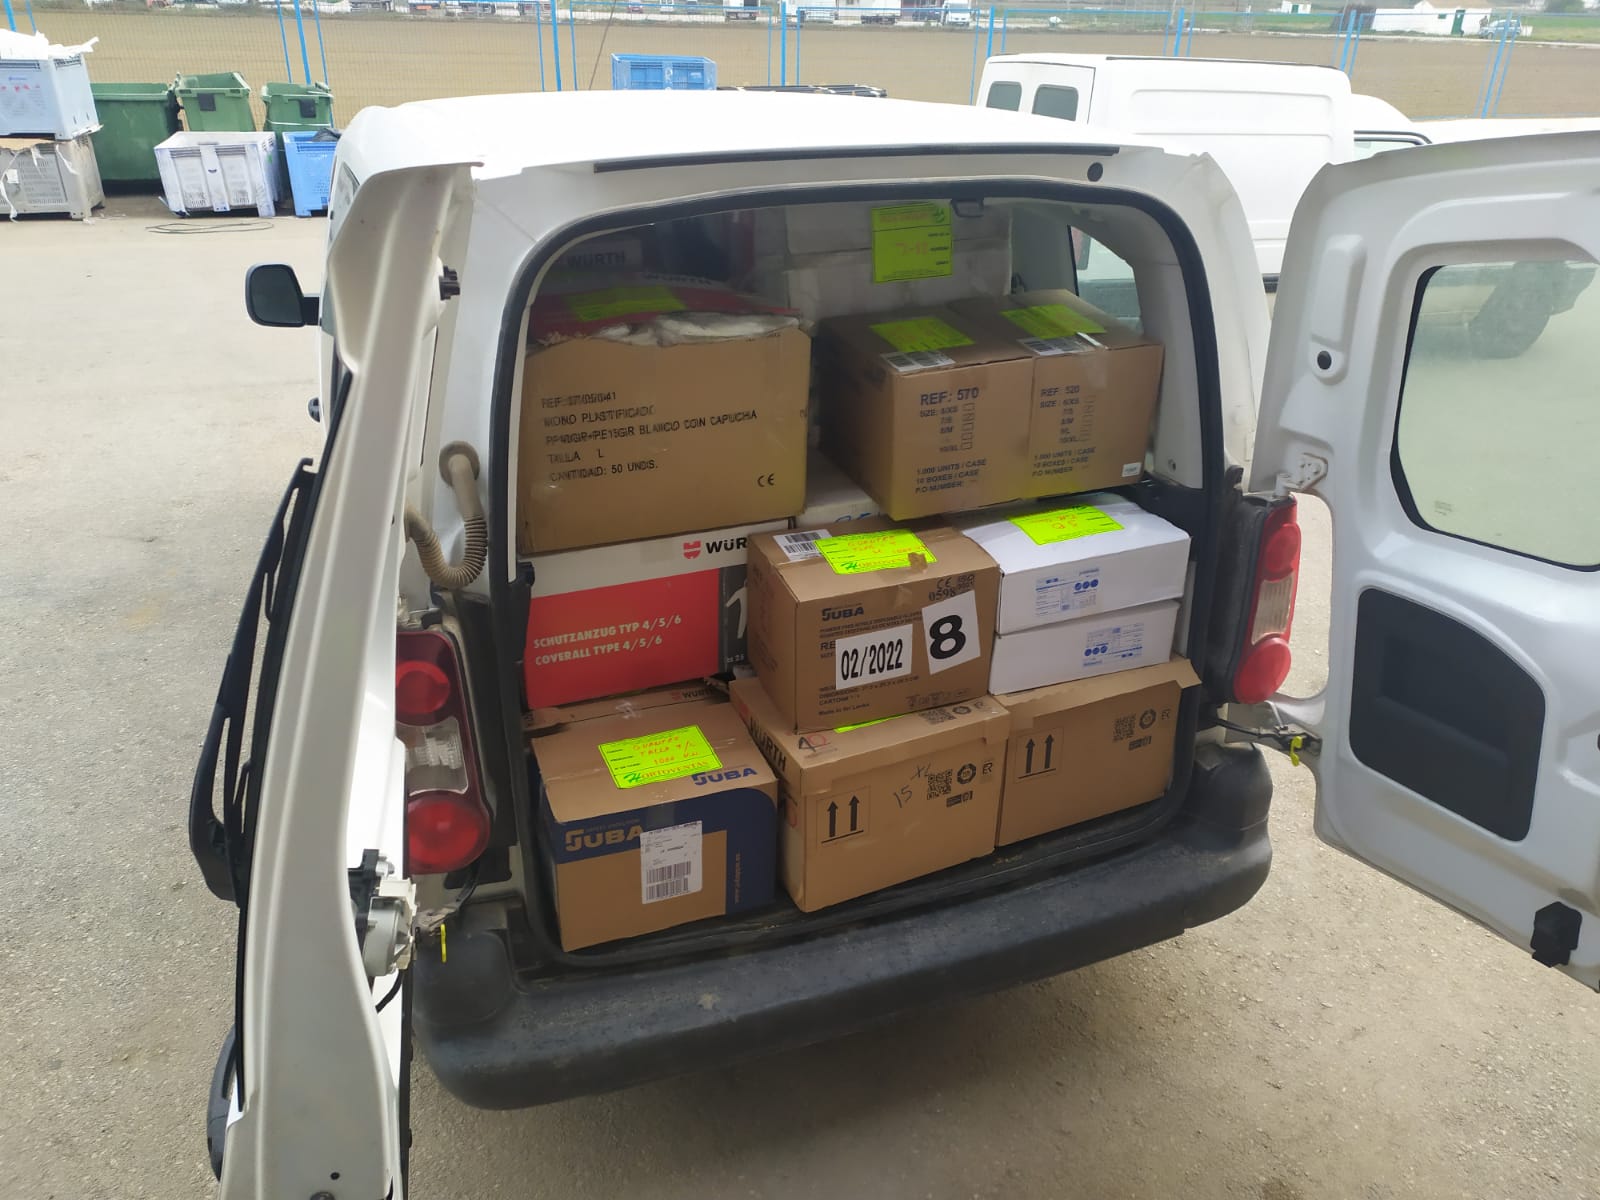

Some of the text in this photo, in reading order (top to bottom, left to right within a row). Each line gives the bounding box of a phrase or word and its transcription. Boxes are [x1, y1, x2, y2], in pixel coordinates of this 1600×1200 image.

[920, 387, 980, 406] REF: 570
[684, 417, 706, 430] CON
[710, 409, 757, 426] CAPUCHA
[611, 464, 623, 474] 50
[822, 606, 864, 621] JUBA
[533, 614, 682, 649] SCHUTZANZUG TYP 4/5/6
[929, 614, 966, 660] 8
[535, 634, 663, 666] COVERALL TYPE 4/5/6
[840, 637, 903, 681] 02/2022
[691, 767, 758, 786] JUBA
[565, 825, 642, 852] JUBA
